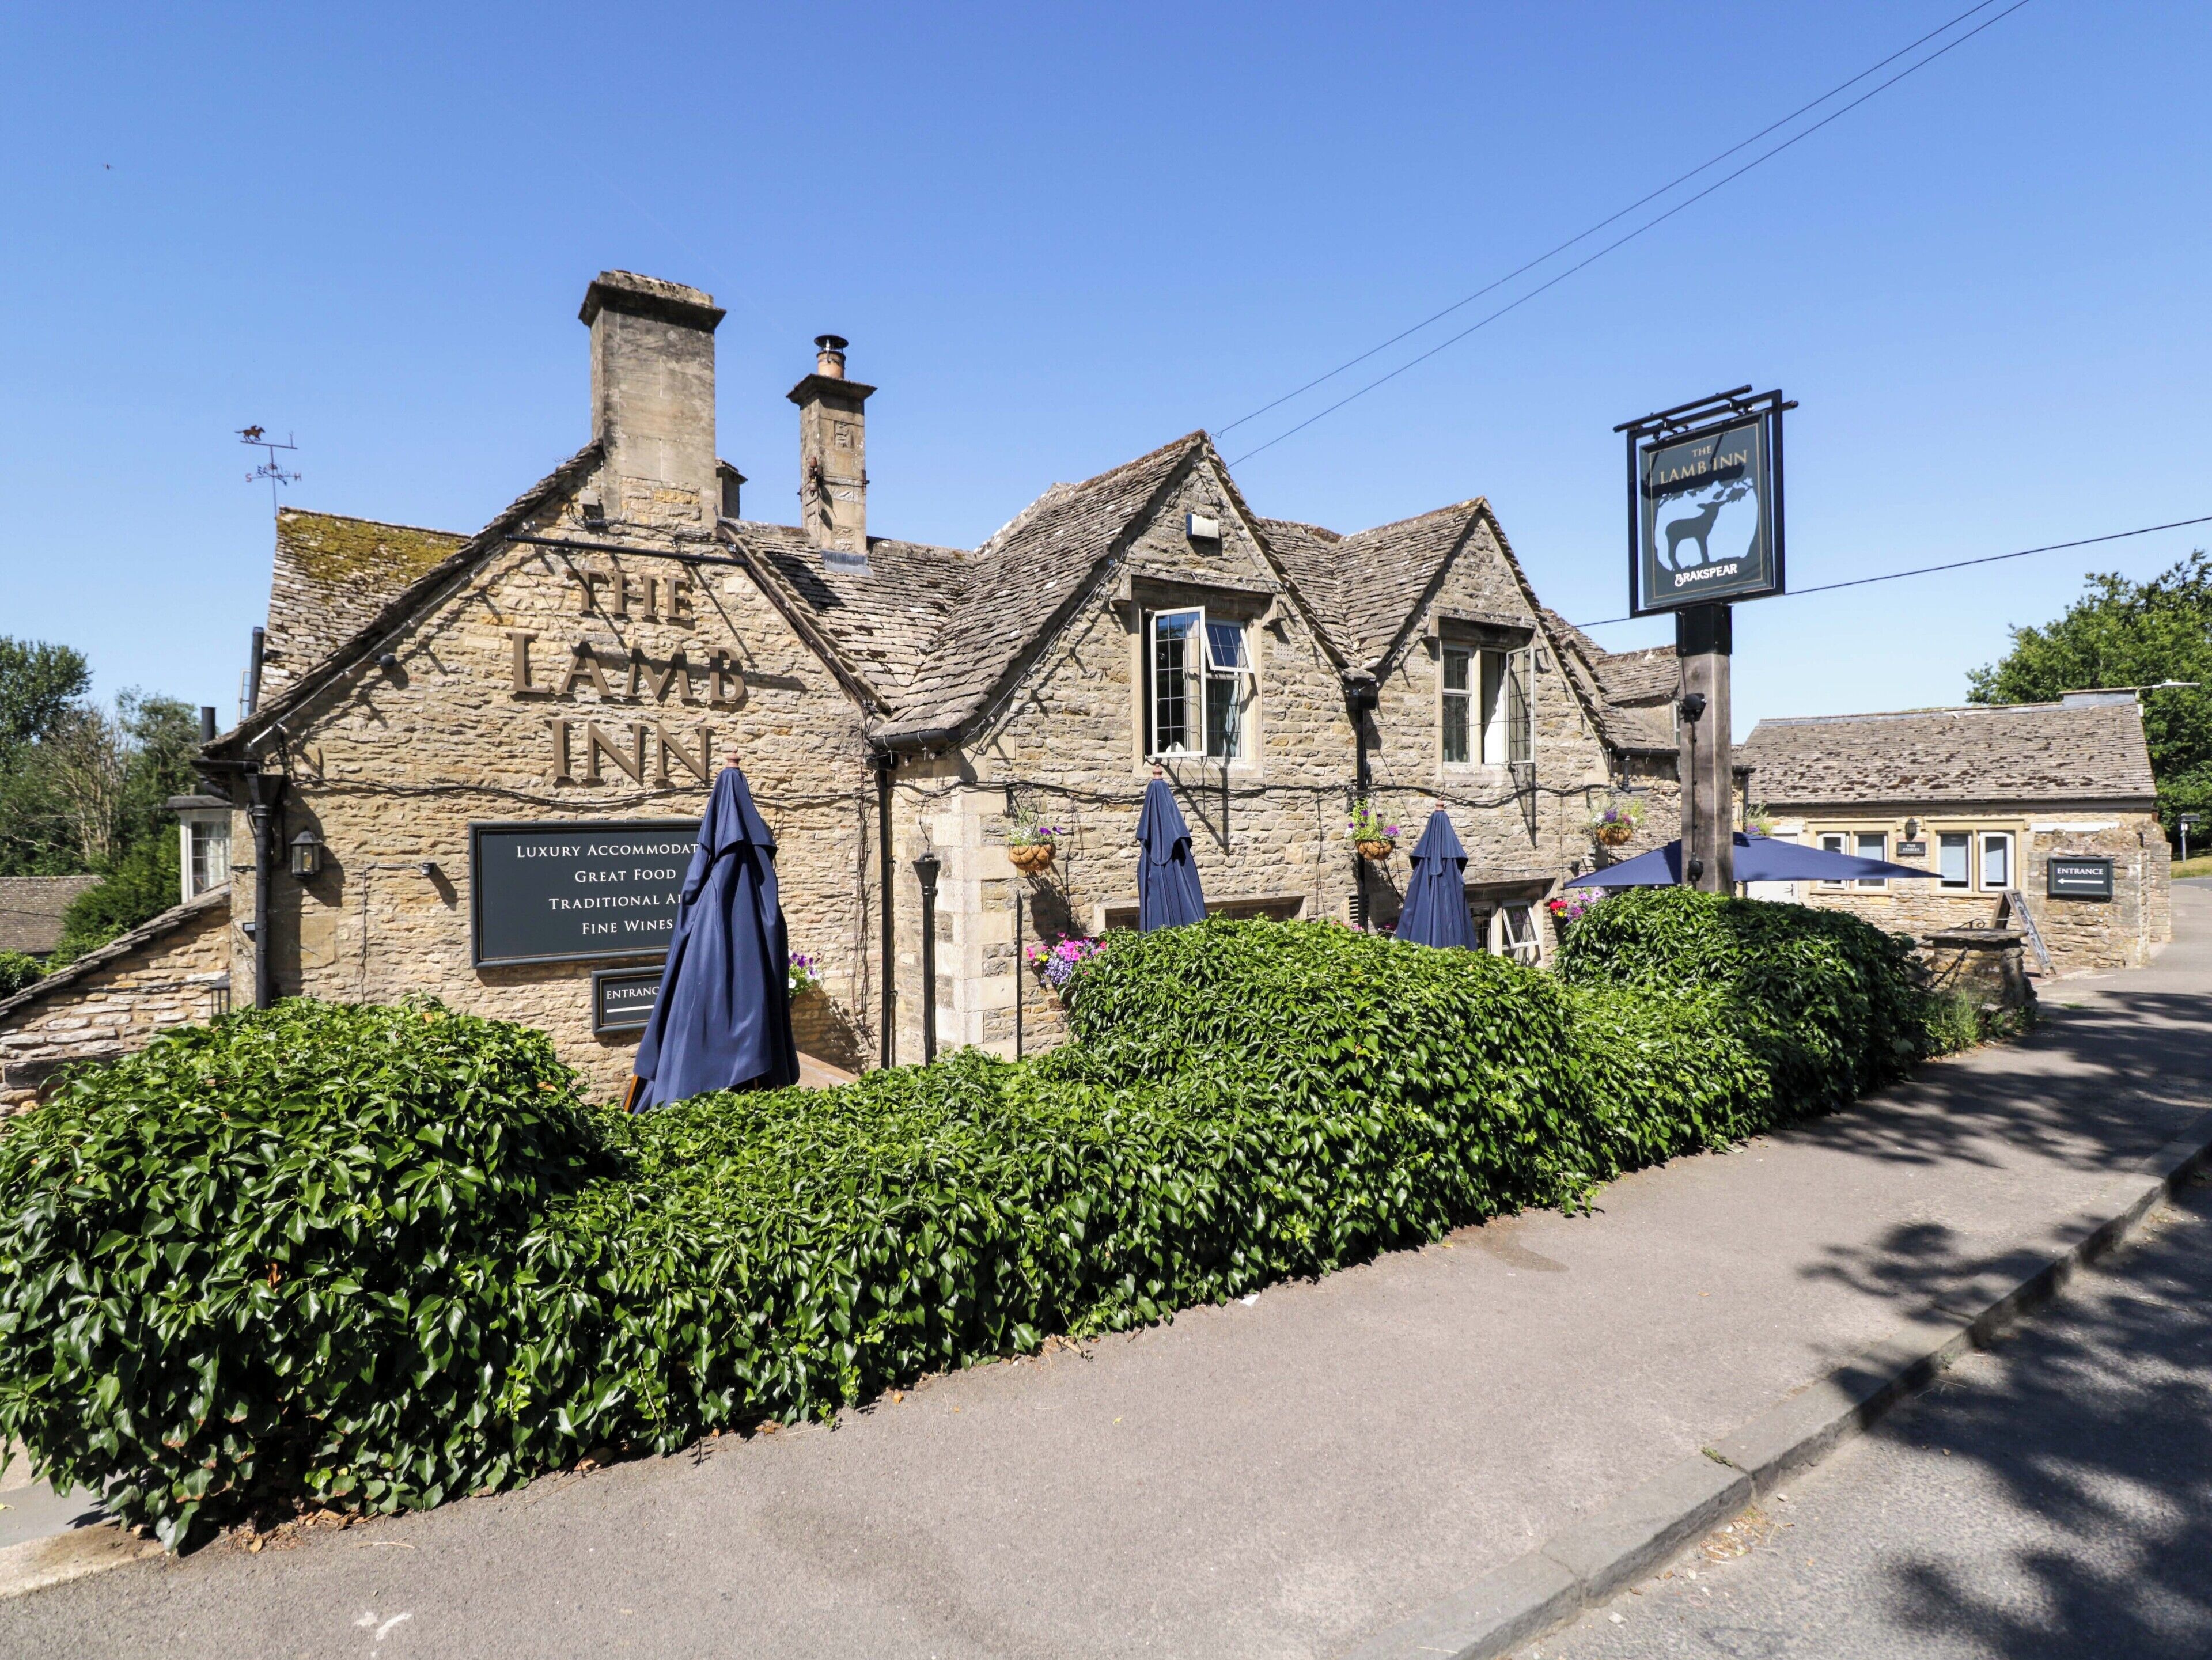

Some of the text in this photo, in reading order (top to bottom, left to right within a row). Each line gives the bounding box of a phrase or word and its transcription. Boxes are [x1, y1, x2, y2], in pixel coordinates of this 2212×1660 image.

[1691, 445, 1712, 457] THE
[1660, 449, 1748, 484] LAMB INN
[1675, 563, 1738, 587] BRAKSPEAR
[566, 569, 691, 619] THE
[506, 632, 746, 703] LAMB
[545, 719, 711, 782] INN
[517, 844, 698, 858] LUXURY ACCOMMODAT
[575, 869, 676, 882] GREAT FOOD
[548, 895, 660, 910] TRADITIONAL
[582, 919, 673, 935] FINE WINES
[607, 986, 660, 999] ENTRANC
